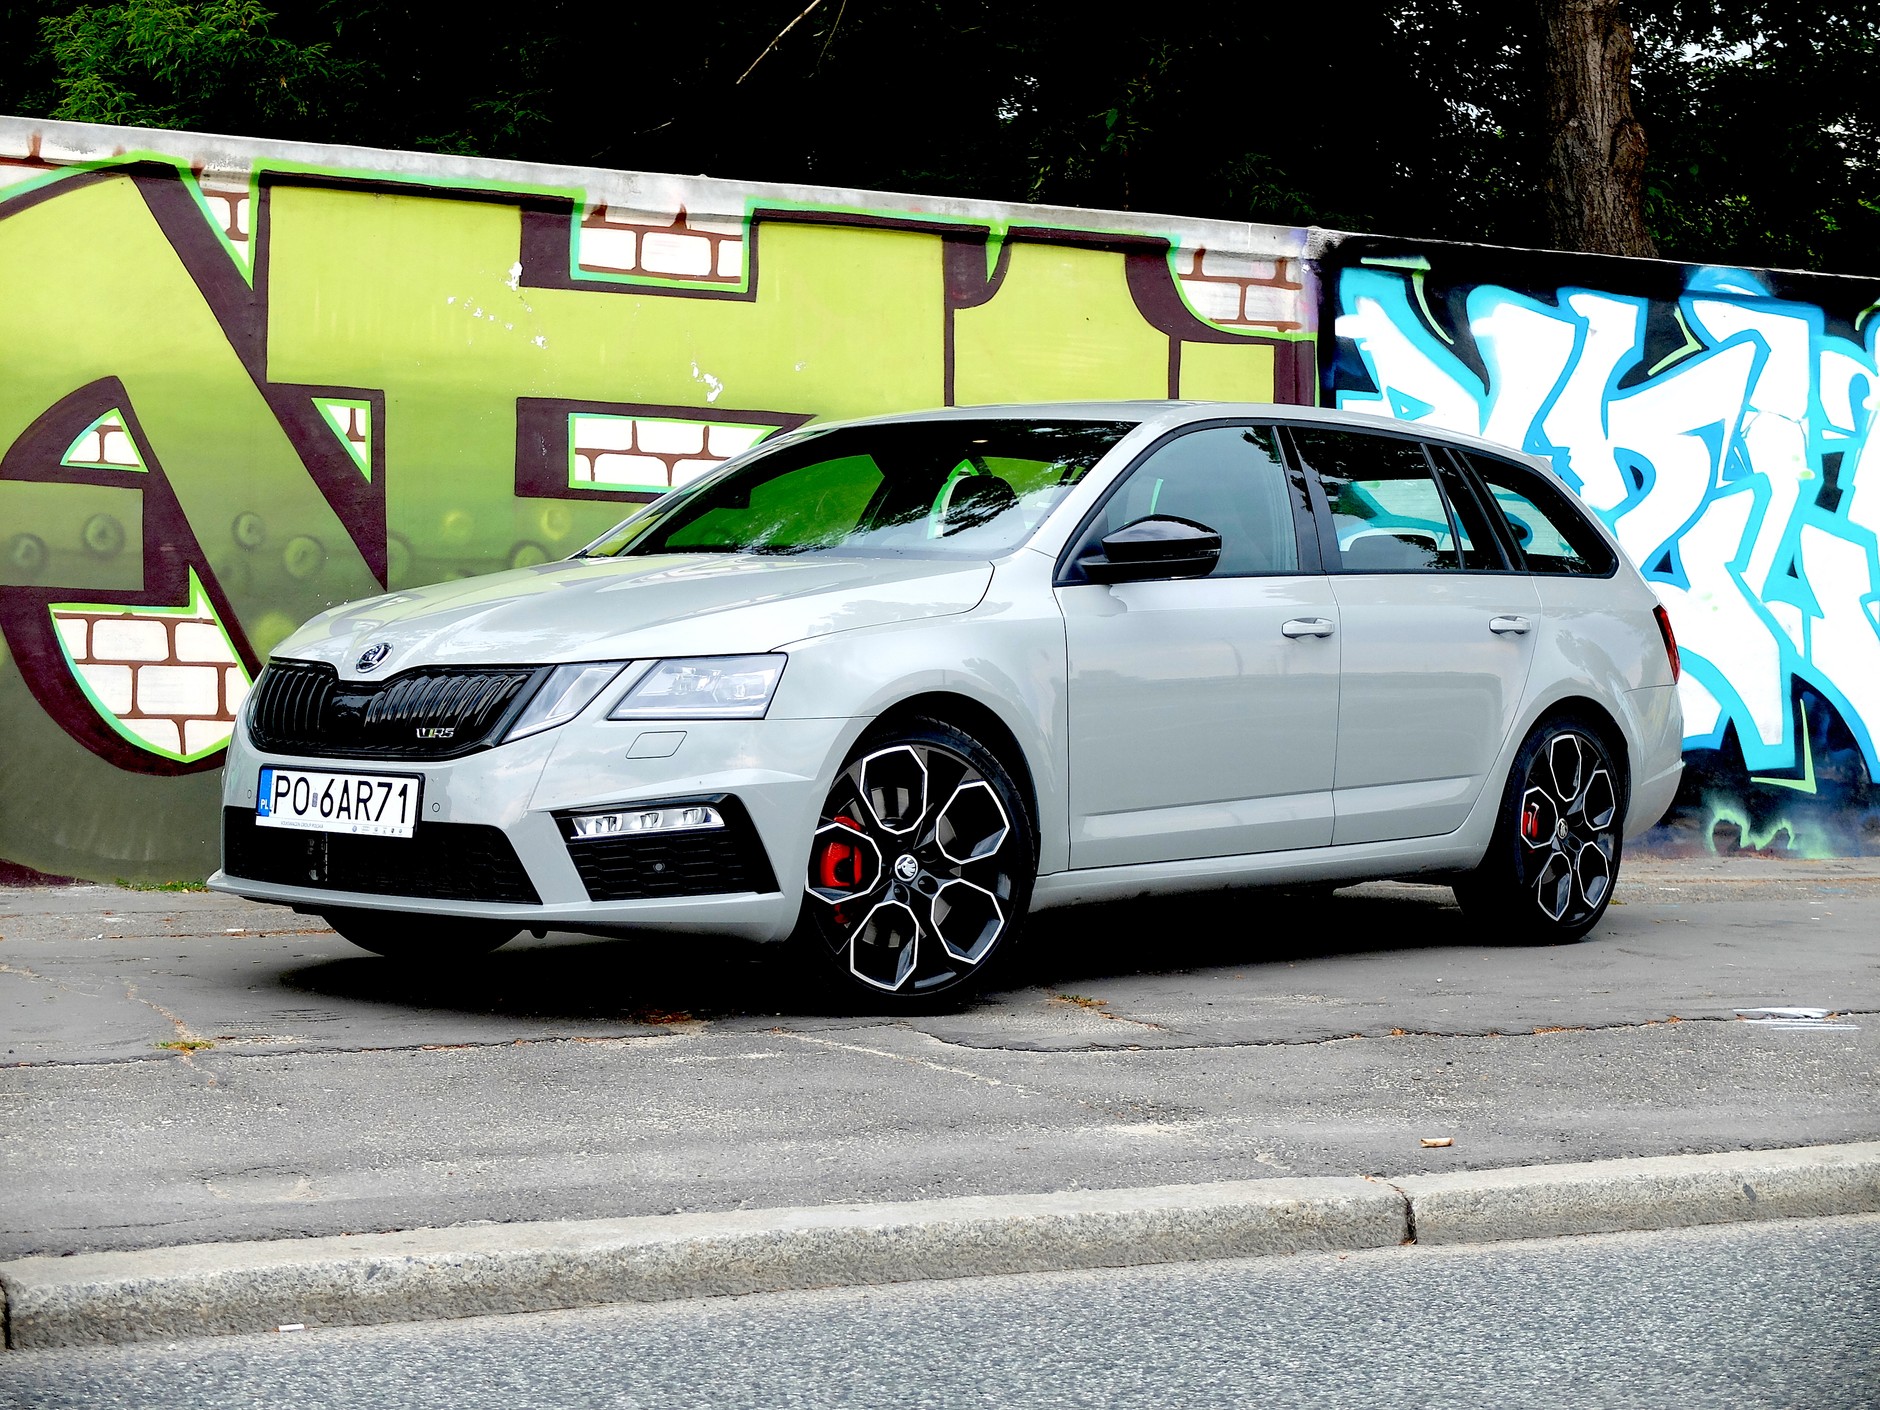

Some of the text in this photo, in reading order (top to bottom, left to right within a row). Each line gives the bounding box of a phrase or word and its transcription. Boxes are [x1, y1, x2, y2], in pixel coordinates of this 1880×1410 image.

[260, 798, 269, 810] PL
[274, 775, 409, 824] PO 6AR71
